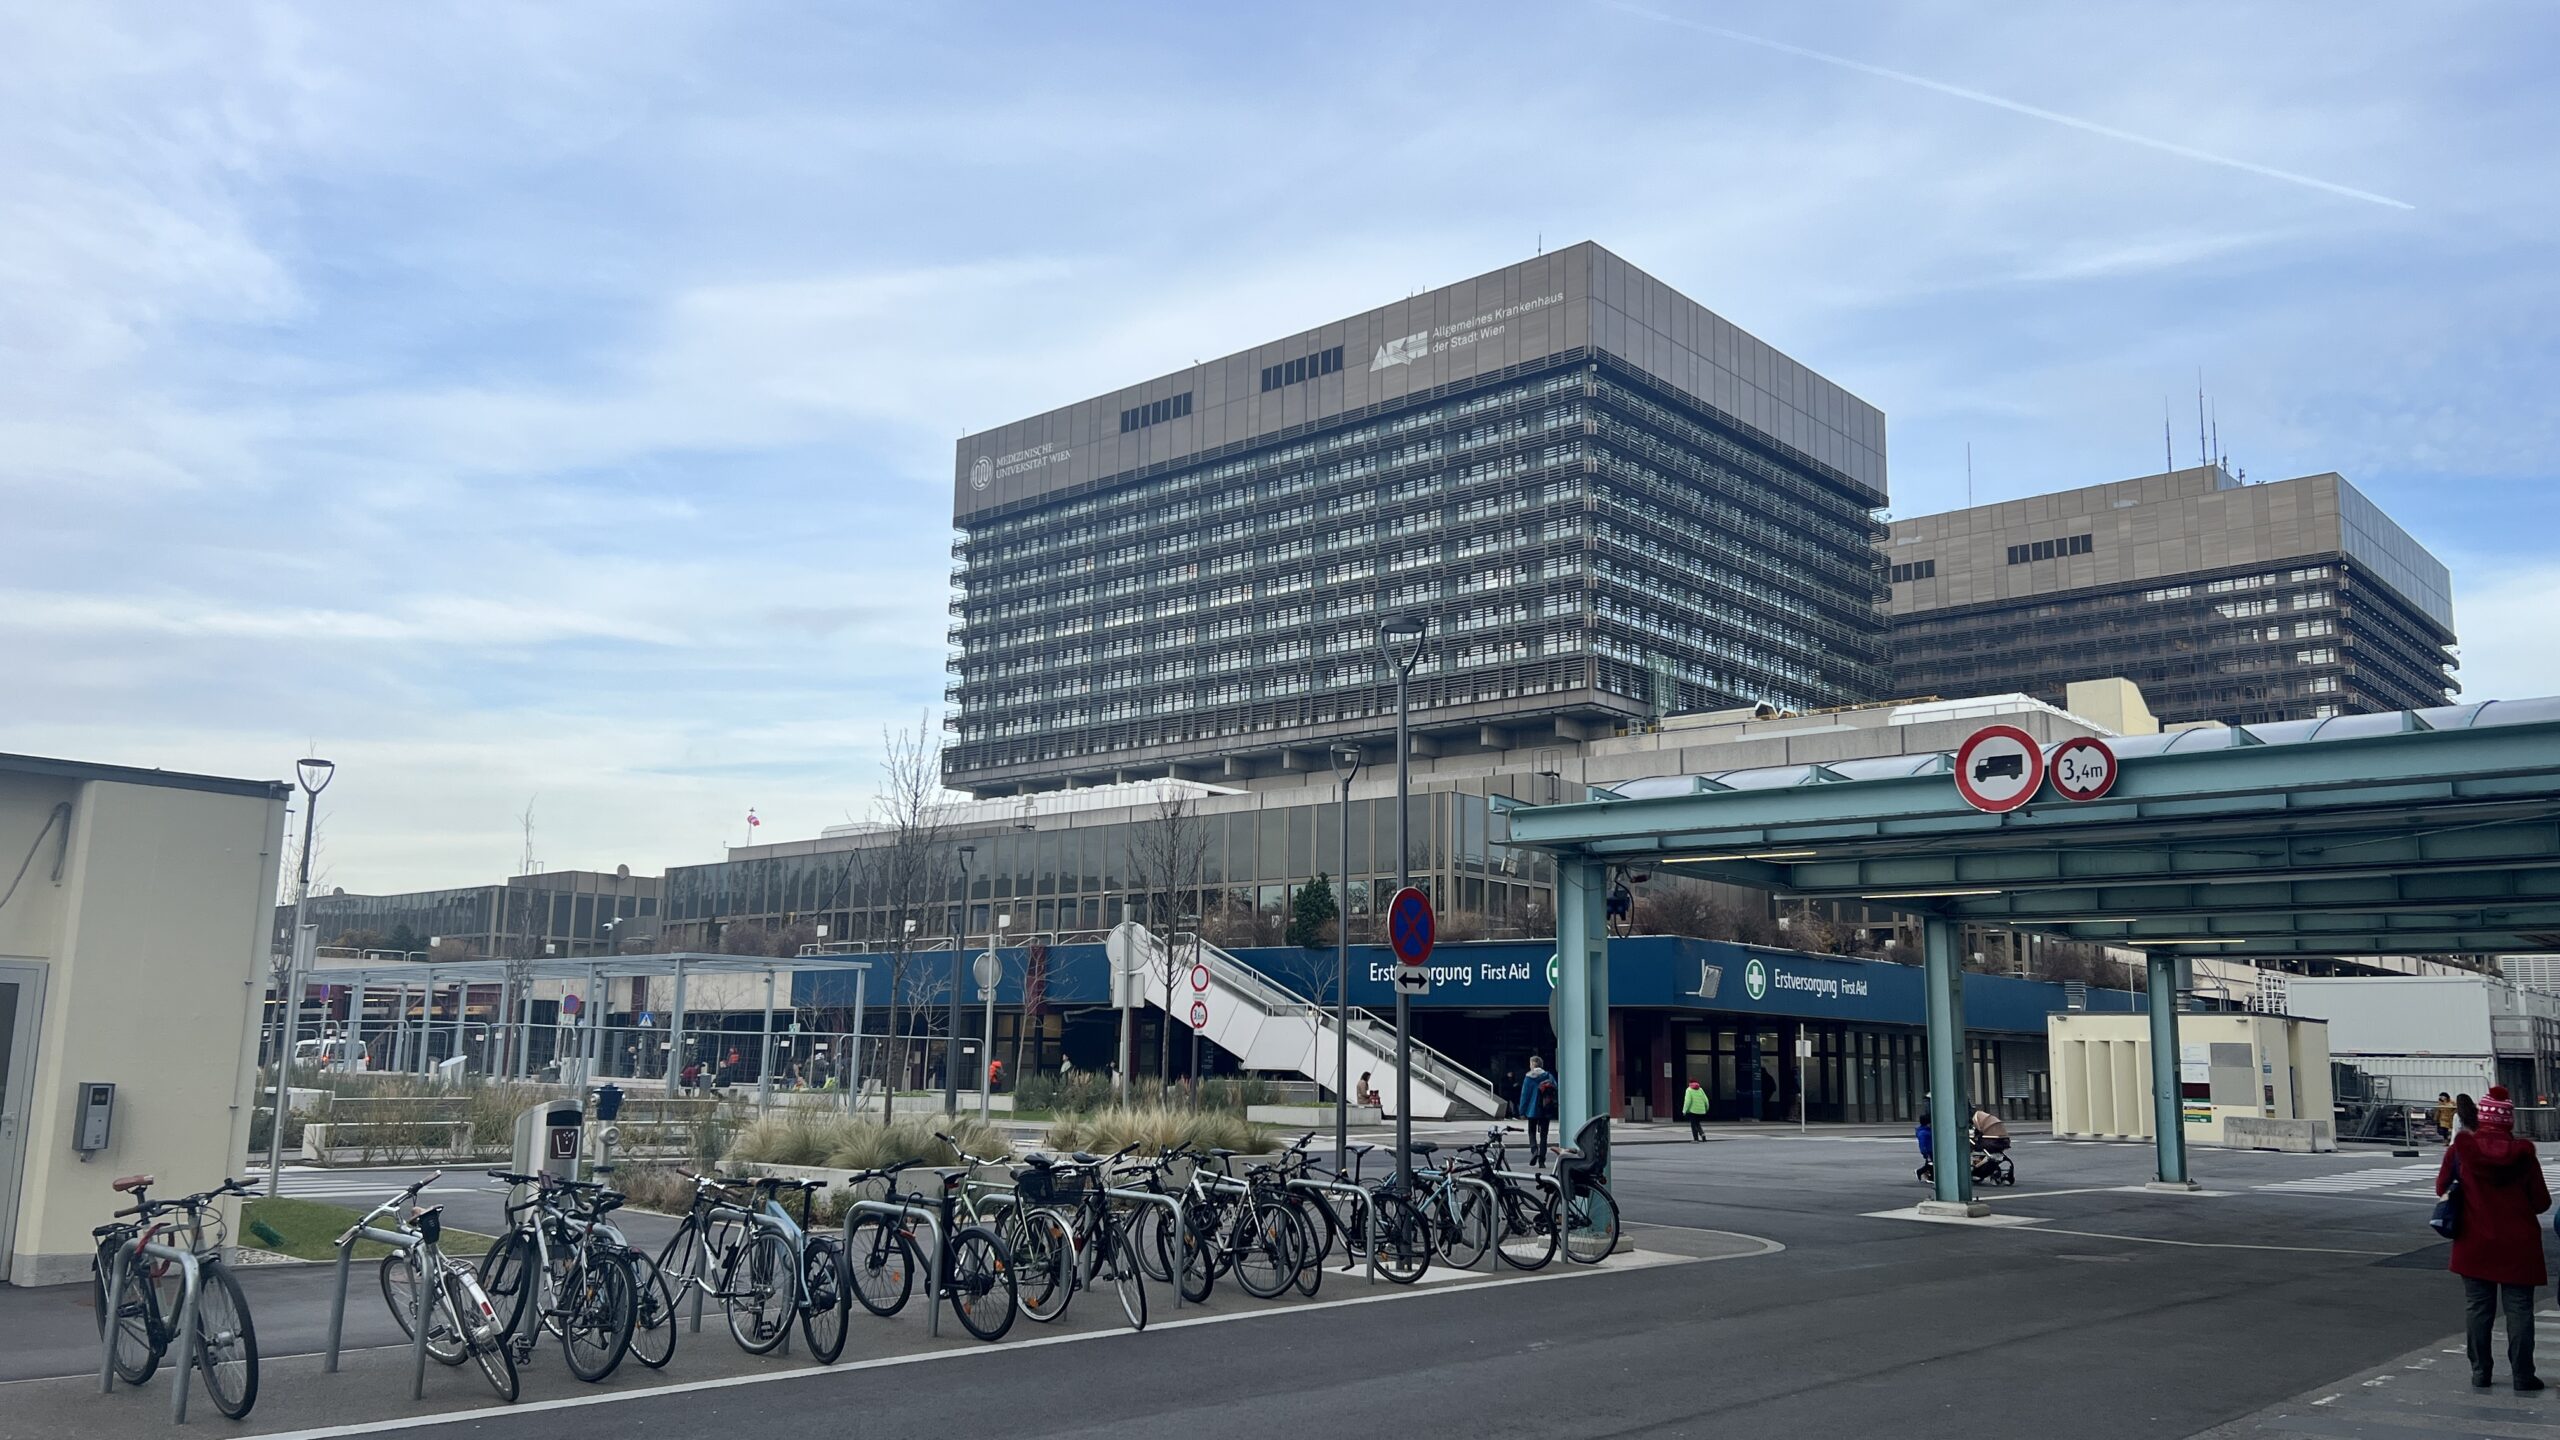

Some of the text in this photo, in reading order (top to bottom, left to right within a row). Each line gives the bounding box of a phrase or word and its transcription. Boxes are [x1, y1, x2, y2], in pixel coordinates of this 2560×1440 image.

[1432, 291, 1564, 338] Allgemeines Krankenhaus
[1432, 324, 1505, 354] der Stadt Wien
[996, 442, 1054, 468] MEDIZINISCHE
[1049, 449, 1072, 463] WIEN
[1369, 962, 1530, 986] Erstrgung First Aid
[1774, 968, 1867, 999] Erstversorgung First Aid
